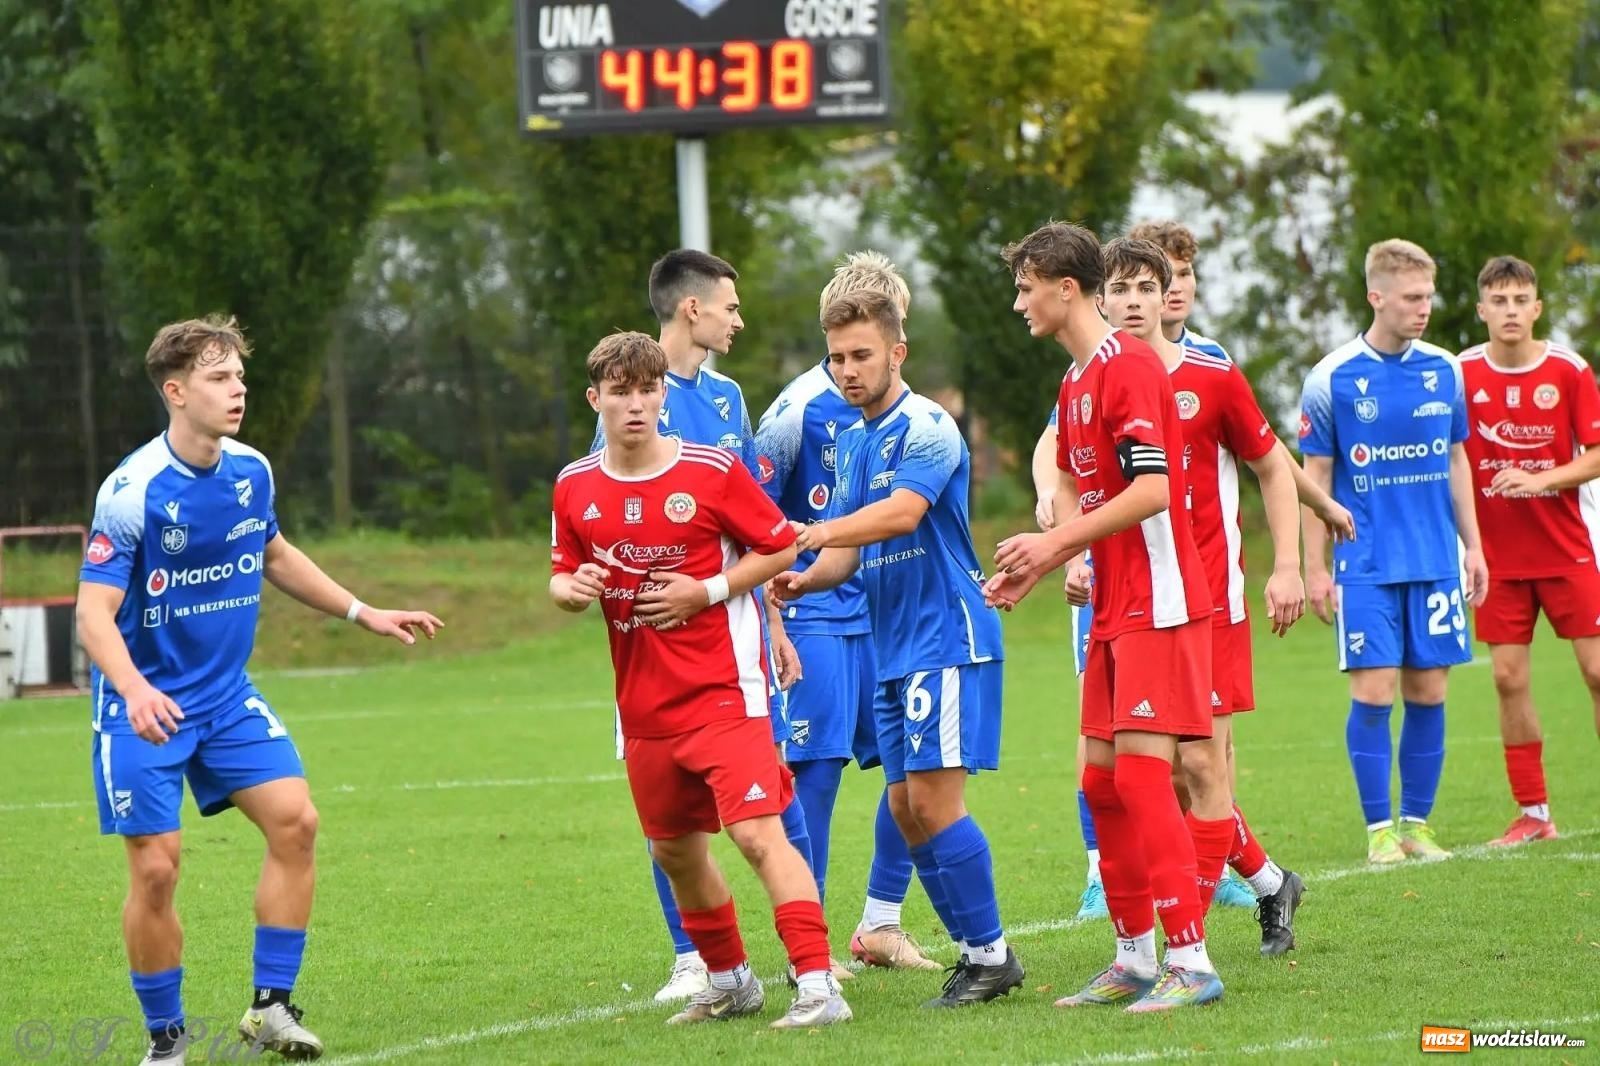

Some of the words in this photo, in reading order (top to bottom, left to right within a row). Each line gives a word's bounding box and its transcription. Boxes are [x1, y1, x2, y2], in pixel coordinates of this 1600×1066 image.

[538, 4, 614, 50] UNIA
[601, 40, 813, 112] 44:38
[1371, 443, 1429, 462] Marco
[620, 544, 687, 562] REKPOL
[171, 563, 233, 588] Marco
[174, 607, 190, 617] MB
[1427, 588, 1466, 635] 23
[906, 671, 931, 722] 6
